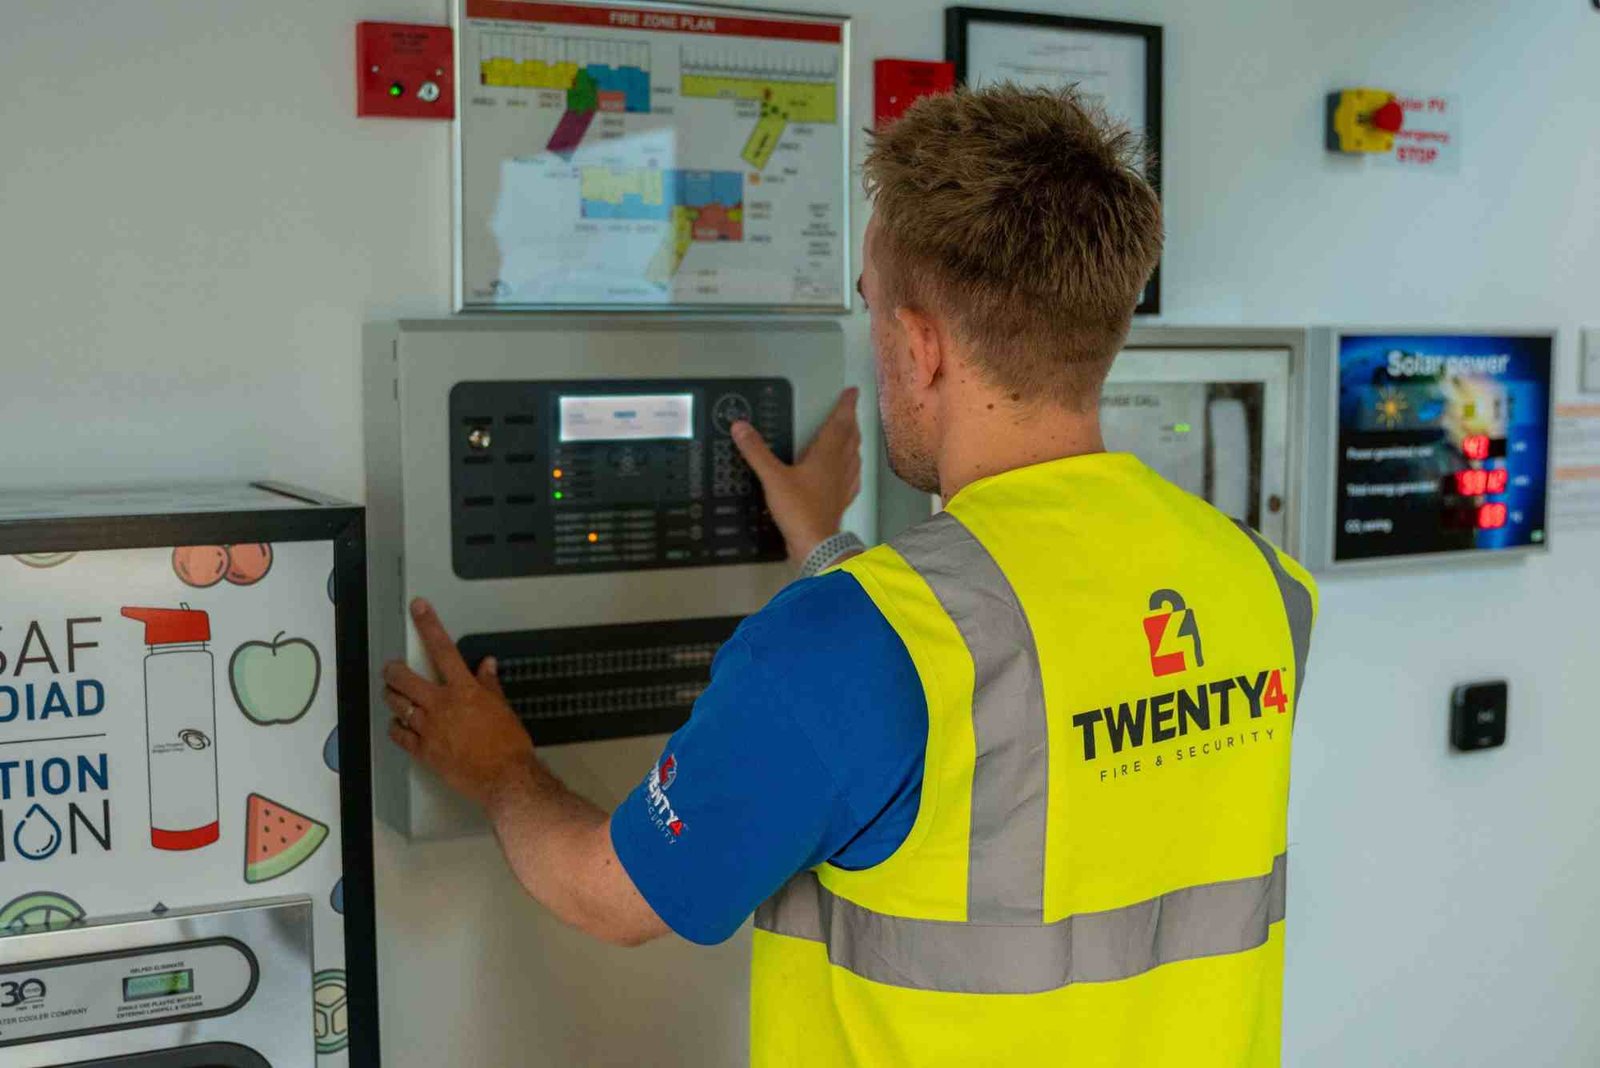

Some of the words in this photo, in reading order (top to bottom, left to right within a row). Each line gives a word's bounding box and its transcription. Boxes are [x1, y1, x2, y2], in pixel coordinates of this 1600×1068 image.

[609, 11, 640, 26] FIRE
[643, 14, 678, 29] ZONE
[681, 17, 716, 32] PLAN
[1397, 147, 1437, 163] STOP
[1387, 350, 1443, 377] Solar
[1445, 354, 1511, 377] power
[0, 616, 102, 676] AF
[1072, 669, 1288, 761] TWENTY4
[1100, 760, 1141, 782] FIRE
[1155, 755, 1163, 766] &
[1176, 728, 1275, 761] SECURITY
[50, 1007, 88, 1018] COMPANY
